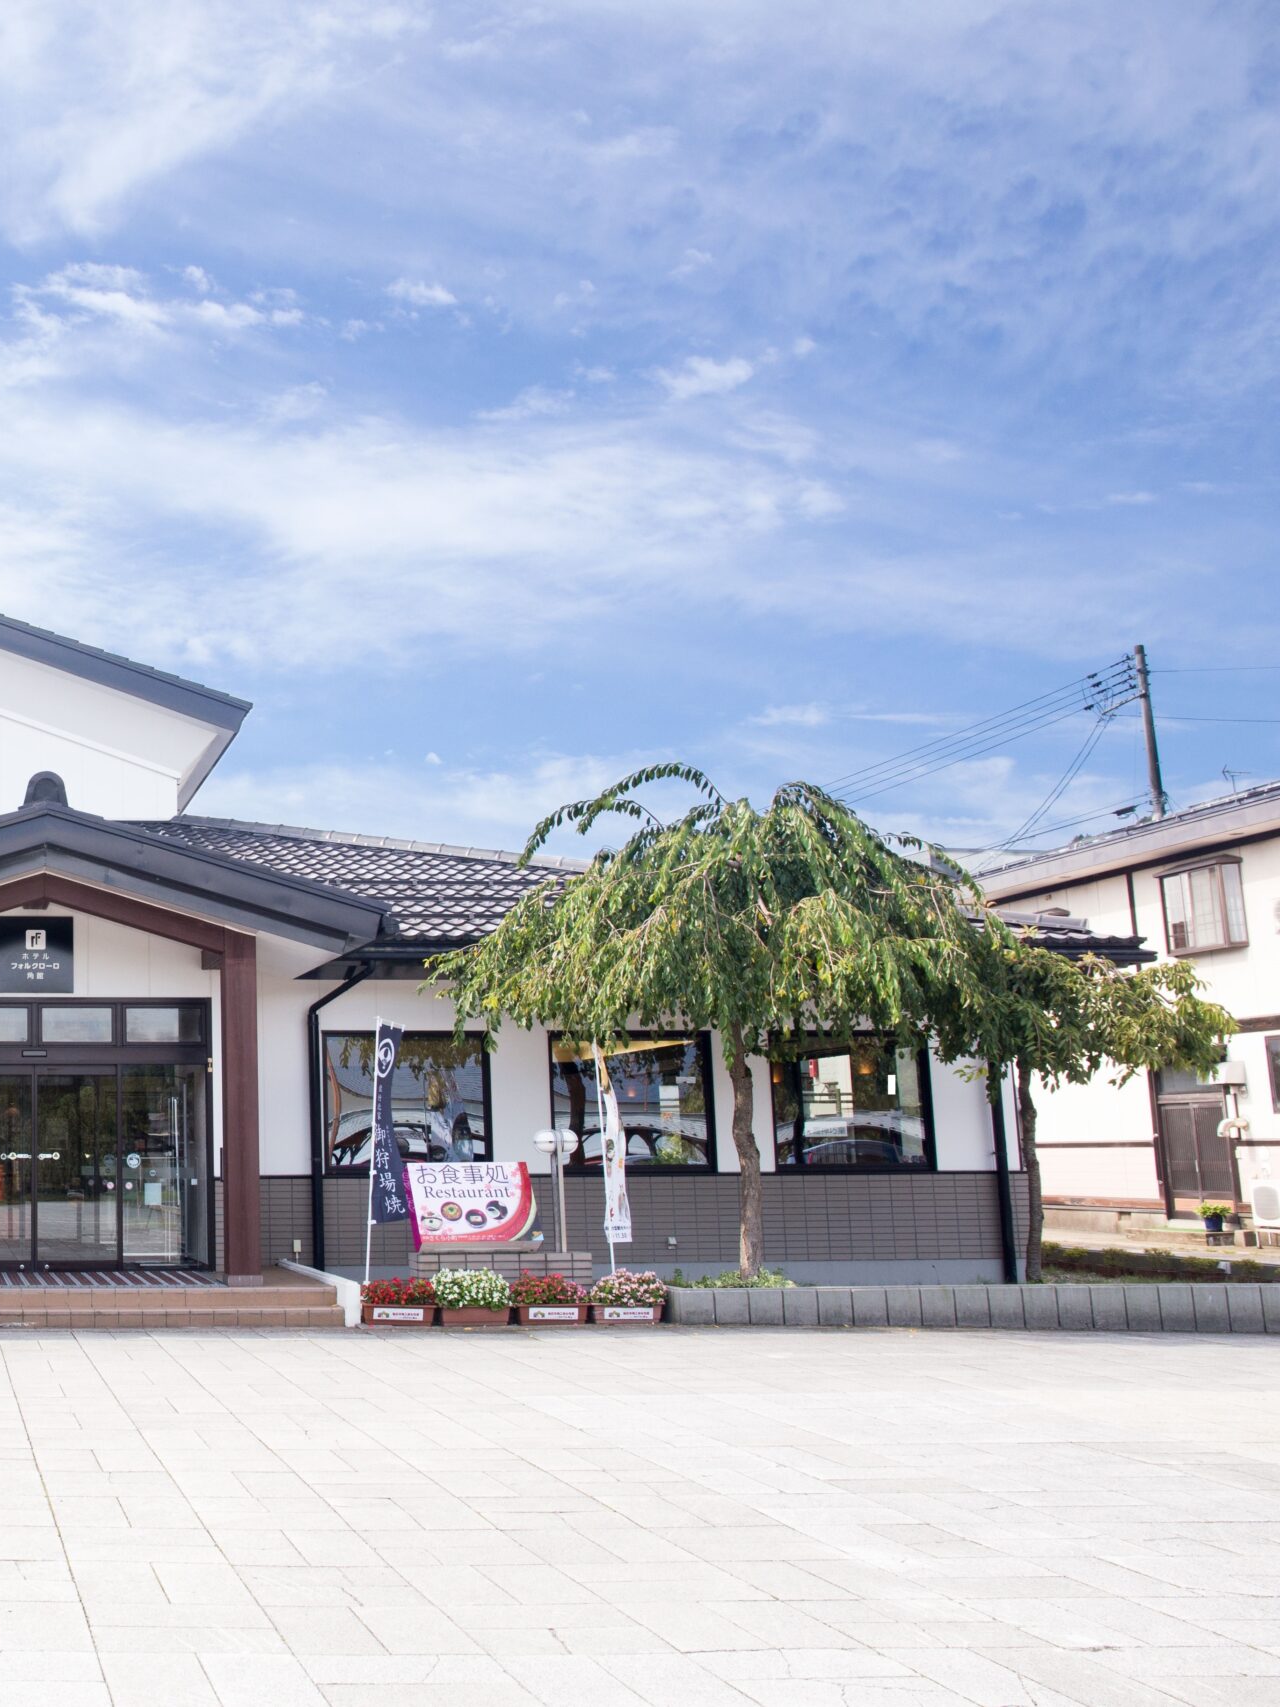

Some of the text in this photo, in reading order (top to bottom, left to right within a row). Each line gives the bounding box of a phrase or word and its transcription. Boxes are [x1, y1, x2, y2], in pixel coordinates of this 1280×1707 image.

[10, 962, 60, 970] フォルクローロ
[26, 971, 44, 980] 角館
[375, 1124, 406, 1214] 御狩場焼
[415, 1164, 510, 1185] お食事処
[423, 1185, 511, 1199] Restaurant
